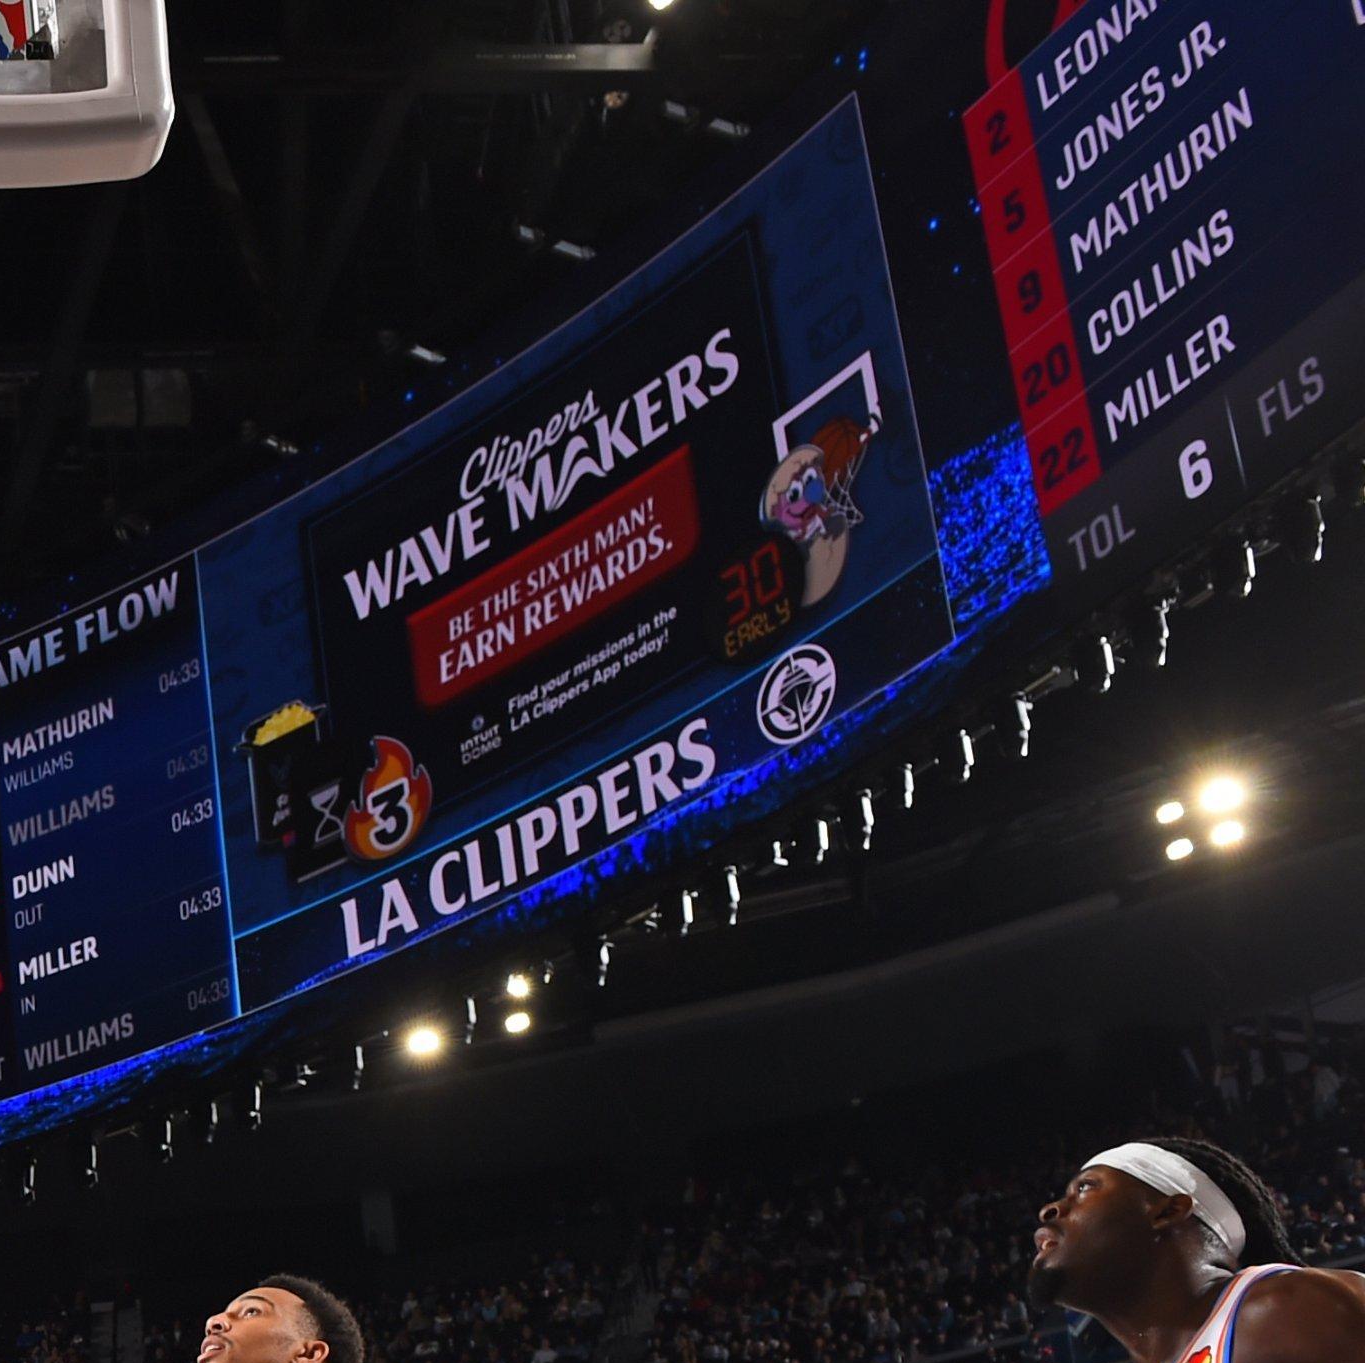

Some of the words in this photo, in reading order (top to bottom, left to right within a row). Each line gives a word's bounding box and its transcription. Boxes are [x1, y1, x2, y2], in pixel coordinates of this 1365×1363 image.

[985, 110, 1011, 156] 2
[1003, 190, 1026, 234] 5
[1056, 66, 1165, 191] JONES
[1170, 19, 1228, 90] JR.
[1018, 270, 1042, 315] 9
[1069, 88, 1254, 274] MATHURIN
[1021, 342, 1070, 408] 20
[1087, 209, 1236, 356] COLLINS
[458, 388, 601, 503] Clippers
[1039, 427, 1089, 490] 22
[1104, 314, 1237, 443] MILLER
[342, 497, 491, 621] WAVE
[503, 327, 740, 532] MAKERS
[1068, 504, 1137, 572] TOL
[1178, 438, 1214, 499] 6
[1257, 355, 1326, 438] FLS
[74, 570, 181, 655] FLOW
[438, 619, 515, 685] EARN
[523, 524, 673, 636] REWARDS.
[448, 607, 475, 642] BE
[480, 582, 520, 622] THE
[527, 542, 589, 595] SIXTH
[594, 497, 655, 558] MAN!
[507, 681, 539, 714] Find
[540, 667, 571, 700] your
[573, 633, 635, 677] missions
[637, 621, 652, 639] in
[654, 606, 677, 630] the
[510, 712, 531, 732] LA
[532, 680, 591, 721] Clippers
[592, 661, 620, 688] App
[622, 628, 670, 674] today!
[1, 697, 115, 765] MATHURIN
[4, 751, 74, 793] WILLIAMS
[8, 785, 116, 847] WILLIAMS
[11, 855, 75, 900] DUNN
[170, 798, 215, 833] 04:33
[339, 878, 418, 960] LA
[425, 716, 718, 916] CLIPPERS
[13, 903, 44, 930] OUT
[18, 935, 99, 985] MILLER
[178, 887, 222, 921] 04:33
[24, 1012, 135, 1071] WILLIAMS
